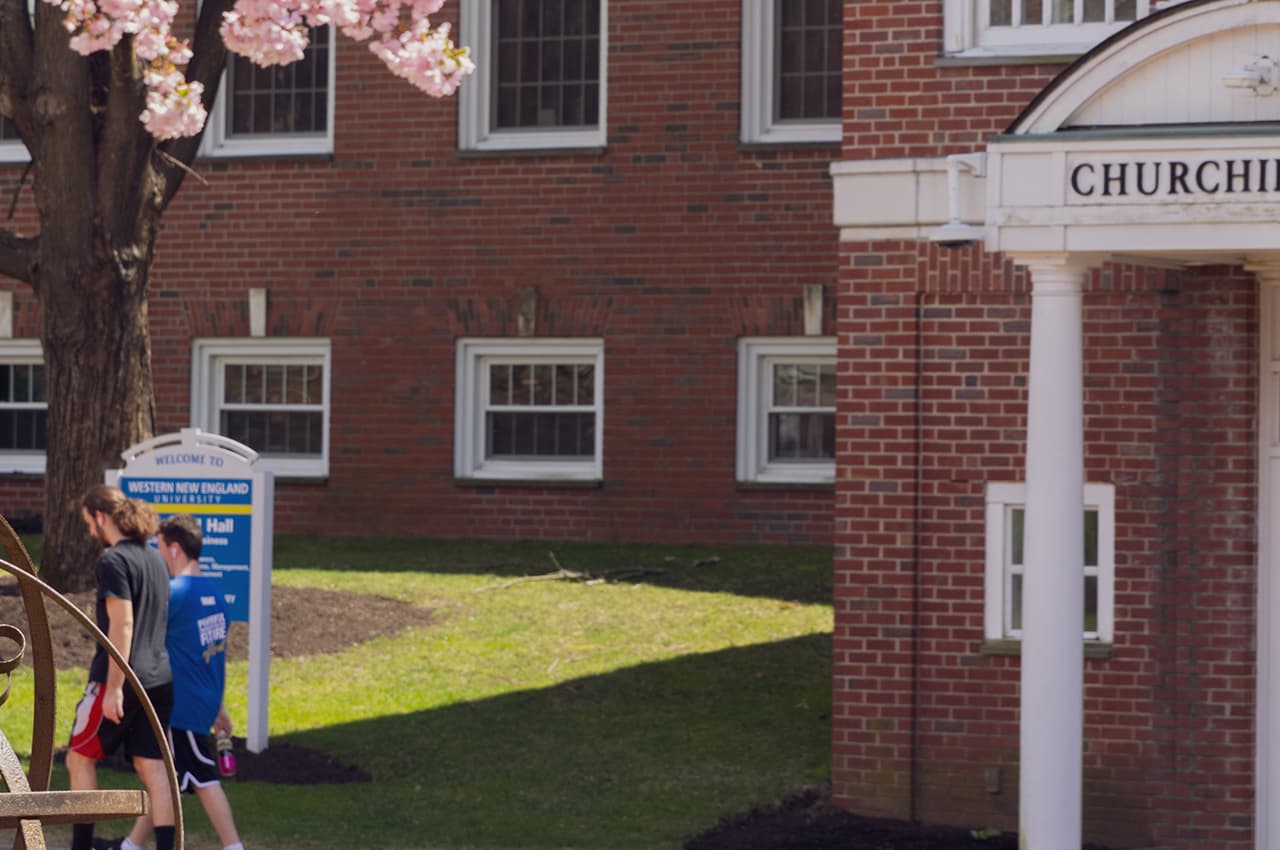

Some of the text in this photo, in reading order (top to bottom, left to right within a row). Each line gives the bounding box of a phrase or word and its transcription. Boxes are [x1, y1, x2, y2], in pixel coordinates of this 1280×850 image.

[155, 453, 225, 468] WELCOME TO
[128, 481, 249, 495] WESTERN NEW ENGLAND
[153, 494, 222, 504] UNIVERSITY
[206, 517, 234, 533] Hall
